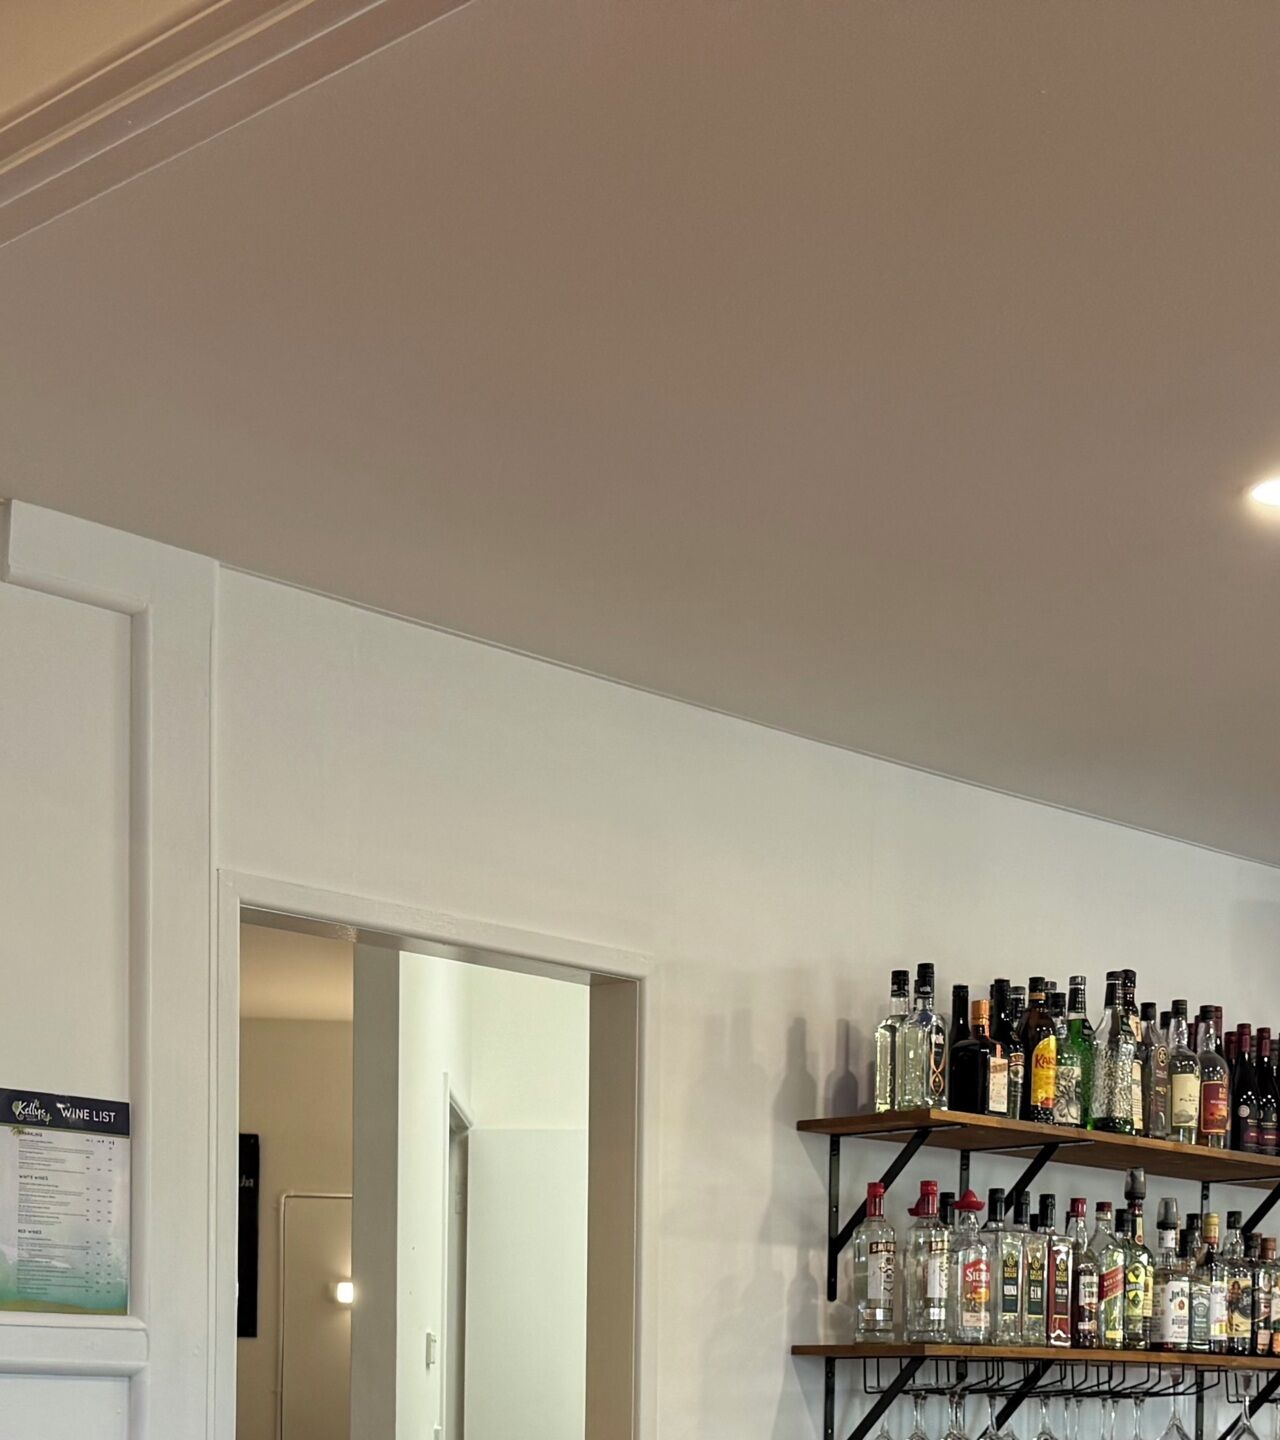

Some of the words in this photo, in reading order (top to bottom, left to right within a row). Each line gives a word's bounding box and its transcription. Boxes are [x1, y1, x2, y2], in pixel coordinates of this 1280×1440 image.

[60, 1105, 90, 1120] WINE
[93, 1110, 116, 1122] LIST
[1030, 1286, 1042, 1298] GIN
